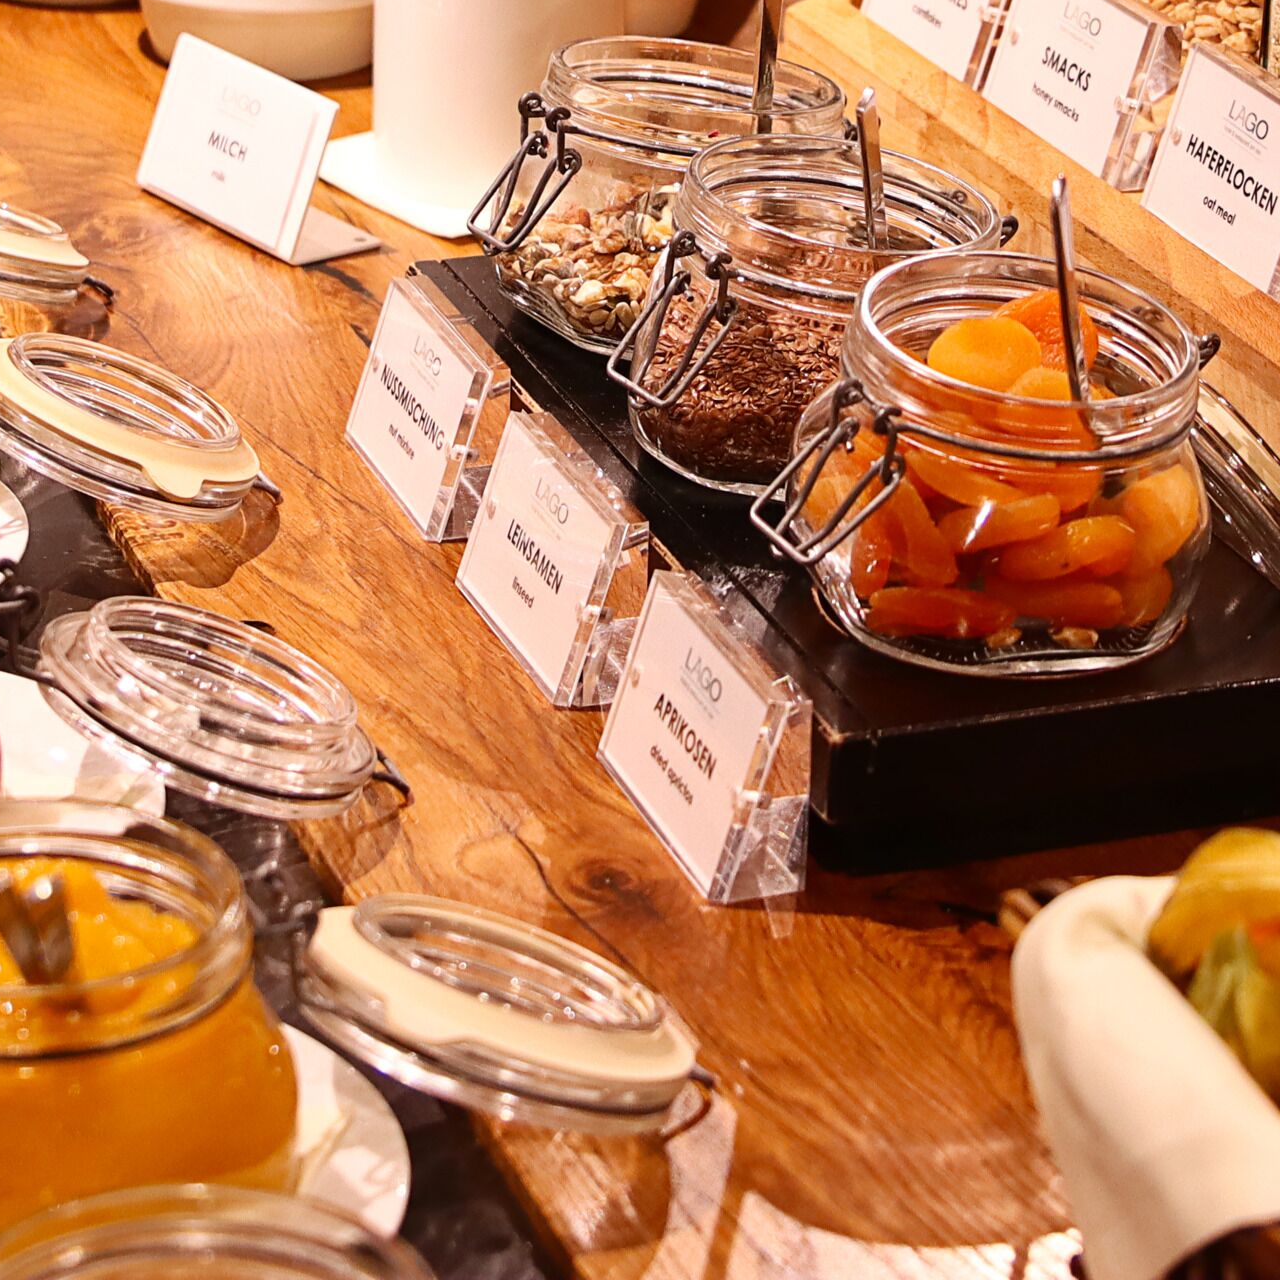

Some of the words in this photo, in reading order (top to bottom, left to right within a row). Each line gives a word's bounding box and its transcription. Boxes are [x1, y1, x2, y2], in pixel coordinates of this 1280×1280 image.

[1063, 1, 1102, 37] LAGO
[1042, 46, 1091, 92] SMACKS
[1032, 83, 1054, 106] honey
[1054, 98, 1080, 122] smacks
[1227, 100, 1269, 140] LAGO
[208, 131, 248, 162] MILCH
[1186, 134, 1279, 216] HAFERFLOCKEN
[1202, 195, 1219, 212] oat
[1216, 203, 1236, 226] meal
[414, 335, 442, 376] LAGO
[381, 365, 445, 451] NUSSMISCHUNG
[535, 477, 569, 524] LAGO
[507, 518, 564, 594] LEINSAMEN
[511, 575, 534, 609] linseed
[684, 648, 723, 703] LAGO
[654, 693, 717, 780] APRIKOSEN
[650, 744, 669, 771] dried
